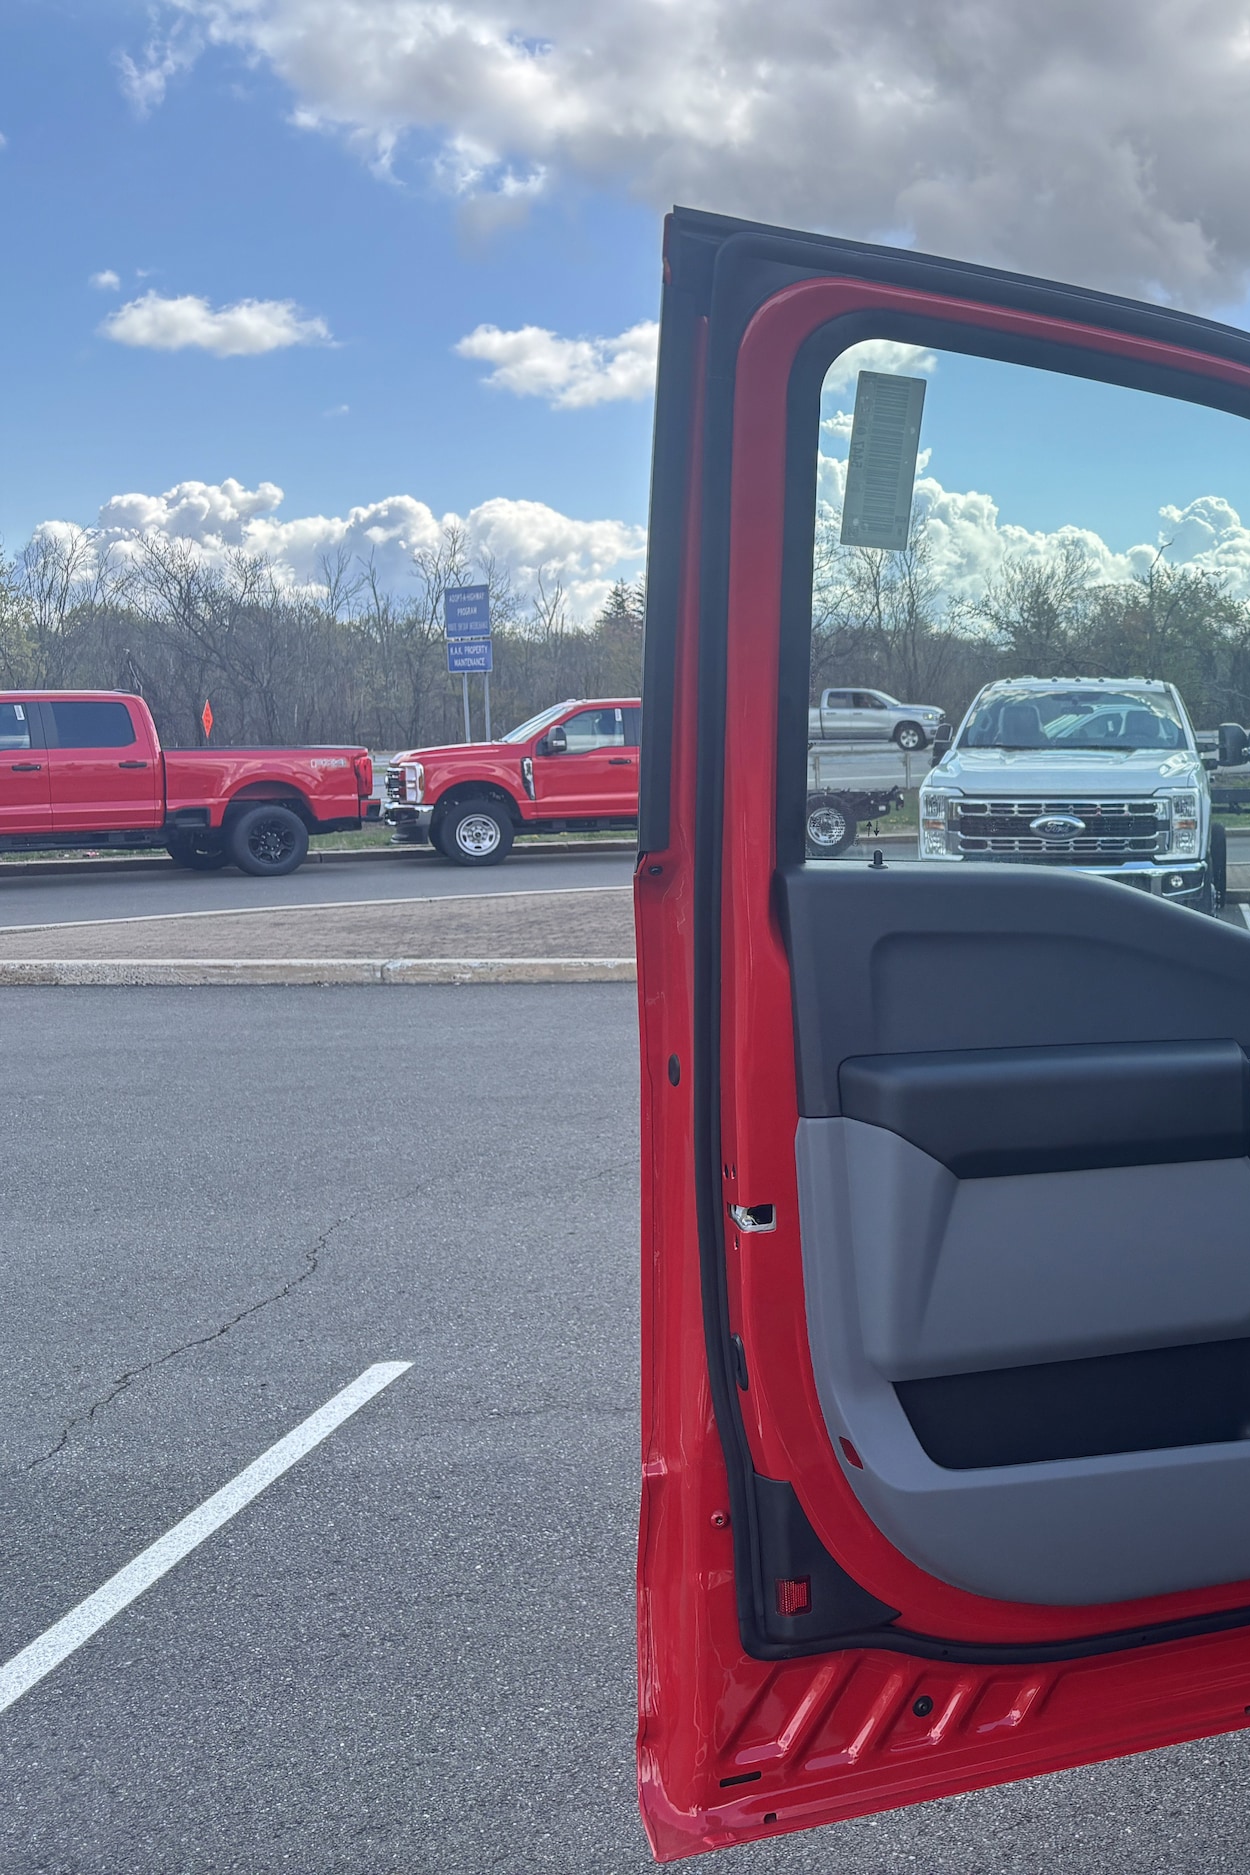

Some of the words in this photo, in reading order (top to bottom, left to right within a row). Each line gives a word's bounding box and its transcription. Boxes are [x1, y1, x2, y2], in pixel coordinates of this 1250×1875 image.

[457, 606, 477, 616] PROGRAM
[464, 645, 488, 654] PROPERTY
[454, 657, 485, 667] MAINTENANCE
